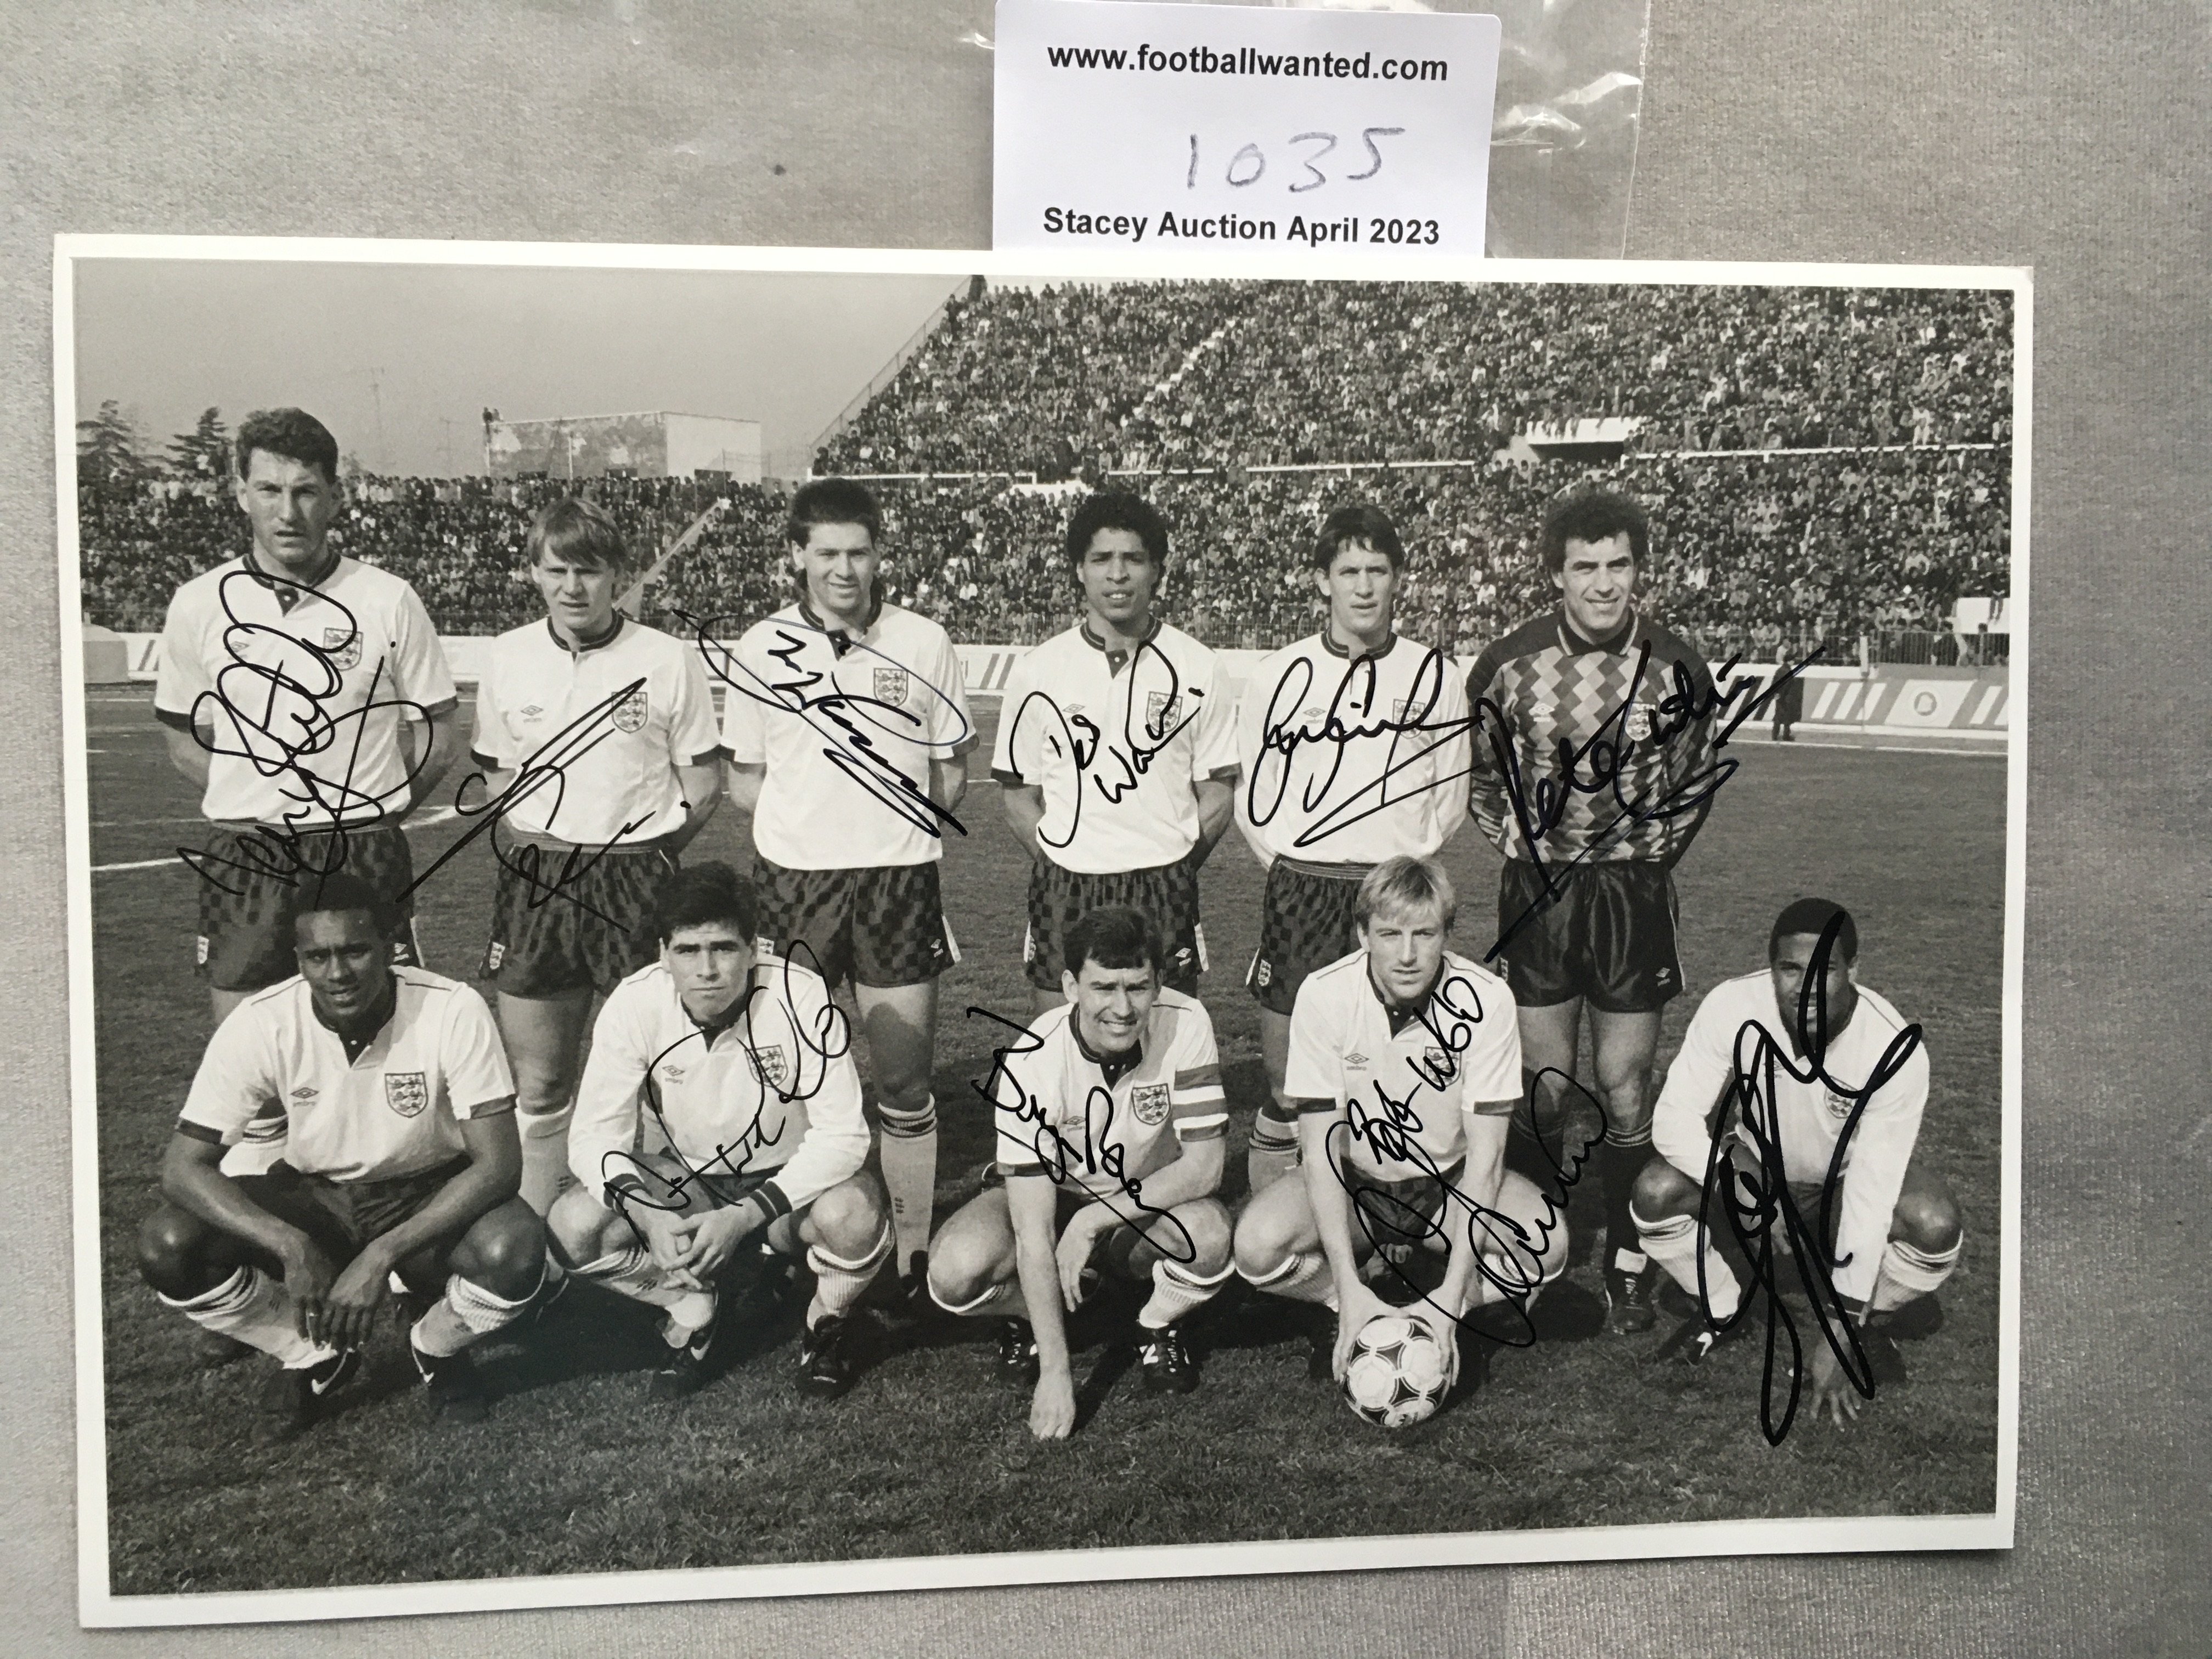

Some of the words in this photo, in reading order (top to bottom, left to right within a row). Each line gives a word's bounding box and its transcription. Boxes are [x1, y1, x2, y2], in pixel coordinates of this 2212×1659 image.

[1047, 43, 1447, 81] www.footballwanted.com
[1186, 127, 1406, 193] 1035
[1043, 207, 1148, 242] Stacey
[1158, 211, 1276, 240] Auction
[1287, 216, 1358, 247] April
[1370, 218, 1439, 245] 2023
